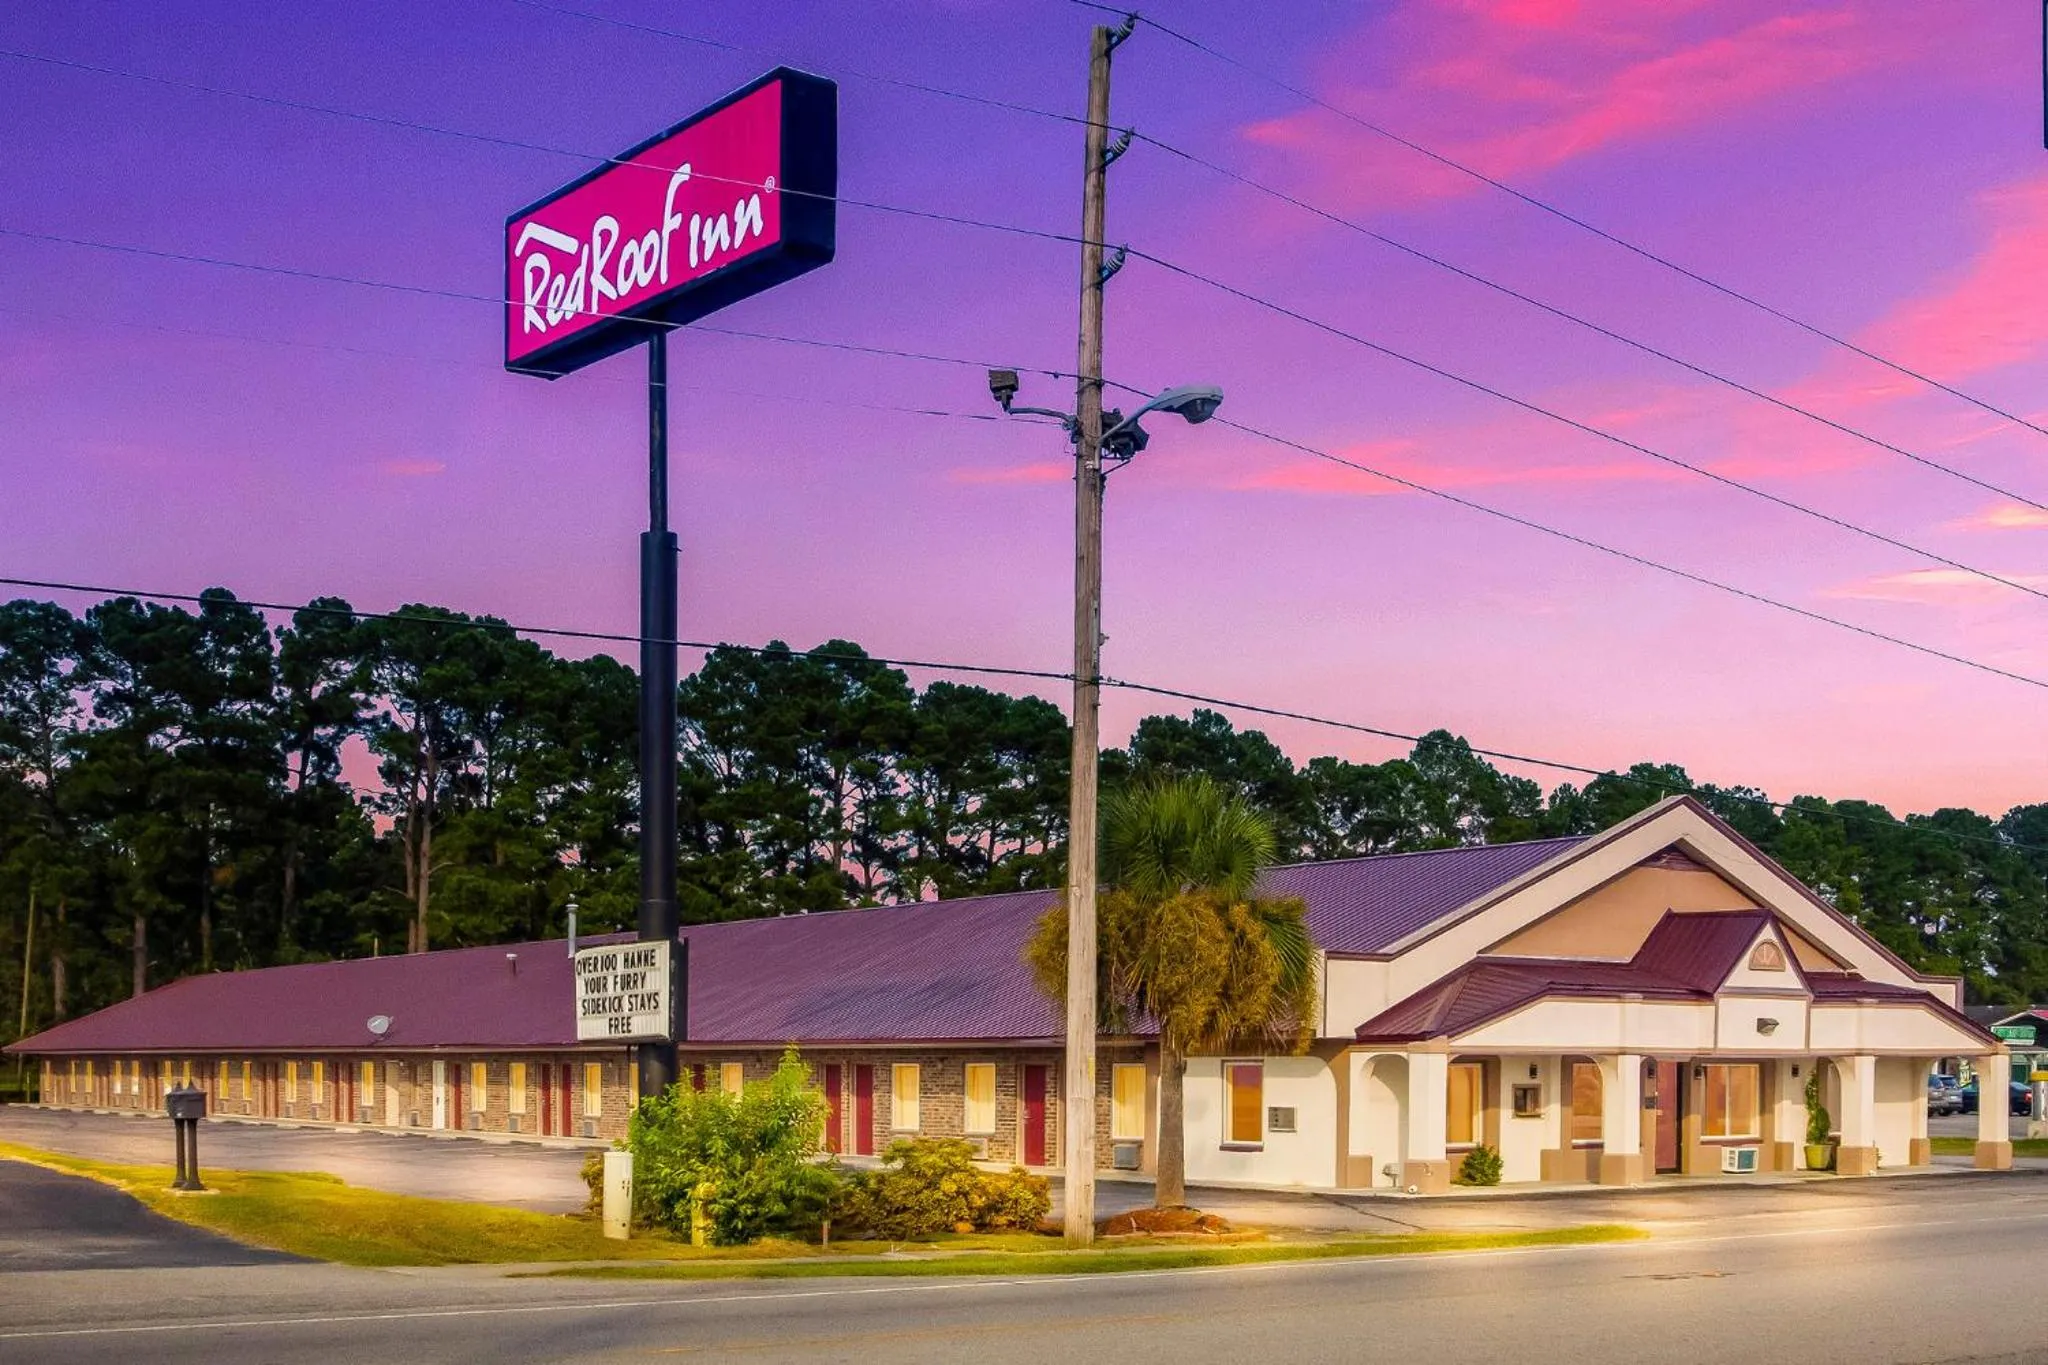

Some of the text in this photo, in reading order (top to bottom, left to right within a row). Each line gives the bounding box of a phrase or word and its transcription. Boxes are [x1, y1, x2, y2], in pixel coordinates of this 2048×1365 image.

[584, 972, 647, 994] YOUR FURRY
[582, 992, 659, 1016] SIDEKICK STAYS
[608, 1016, 632, 1034] FREE
